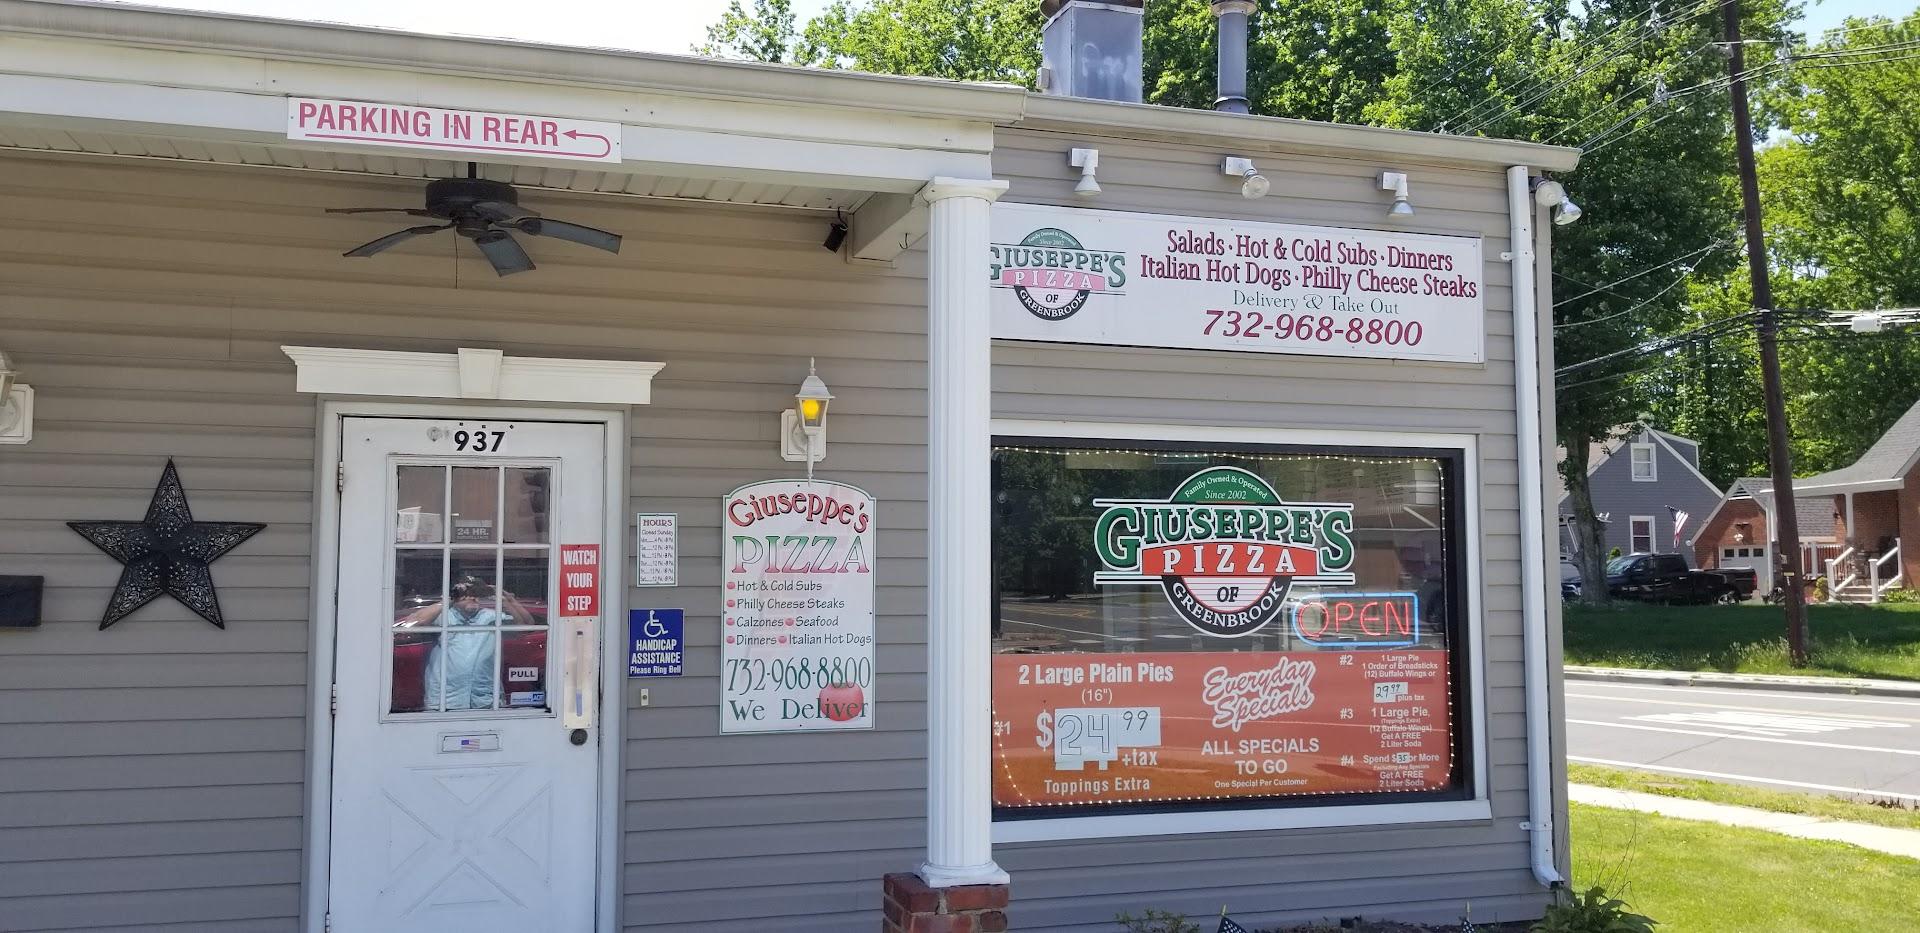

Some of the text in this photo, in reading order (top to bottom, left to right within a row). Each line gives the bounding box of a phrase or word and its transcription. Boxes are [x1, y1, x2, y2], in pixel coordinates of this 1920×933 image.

[299, 102, 559, 146] PARKING IN REAR
[1167, 229, 1453, 271] Salads Hot & Cold Subs Dinners
[1014, 270, 1093, 289] PIZZA
[1140, 254, 1477, 298] Italian Hot Dogs Philly Cheese Steaks
[1020, 289, 1086, 318] GREENBROOK
[1045, 293, 1059, 304] OF
[1234, 289, 1299, 311] Delivery
[1329, 294, 1364, 313] Take
[1370, 297, 1400, 315] Out
[1203, 310, 1423, 346] 732-968-8800
[454, 430, 505, 452] 937
[1185, 475, 1268, 499] Family Owned & Operated
[1205, 490, 1247, 500] Since 2002
[728, 492, 869, 534] Giuseppe's
[457, 527, 489, 536] 24 HR.
[1094, 505, 1354, 571] GIUSEPPE'S
[563, 550, 596, 565] WATCH
[732, 535, 870, 573] PIZZA
[1163, 545, 1296, 574] PIZZA
[566, 572, 593, 588] YOUR
[737, 580, 822, 591] Hot & Cold Subs
[1216, 586, 1240, 603] OF
[567, 595, 592, 611] STEP
[737, 598, 845, 612] Philly Cheese Steaks
[1172, 582, 1284, 628] GREENBROOK
[736, 616, 839, 627] Calzones Seafood
[1299, 601, 1409, 637] OPEN
[636, 639, 677, 651] HANDICAP
[736, 633, 871, 646] Dinners Italian Hot Dogs
[631, 652, 681, 664] ASSISTANCE
[1339, 654, 1353, 666] #2
[1367, 662, 1387, 670] Order
[1387, 654, 1406, 663] Large
[510, 670, 535, 678] PULL
[630, 665, 681, 674] Please Ring Bell
[727, 656, 870, 695] 732-968-8800
[1018, 662, 1175, 686] 2 Large Plain Pies
[1364, 670, 1377, 679] (12)
[1405, 670, 1426, 678] Wings
[1203, 655, 1316, 705] Everyday
[1081, 687, 1113, 705] (16")
[1375, 685, 1389, 698] 29
[1397, 694, 1413, 702] plus
[728, 698, 869, 721] We Deliver
[1212, 683, 1315, 732] Specials
[1340, 706, 1430, 719] #3 1 Large Pie,
[1381, 732, 1394, 740] Get
[1395, 732, 1401, 740] A
[1382, 724, 1407, 732] Buffalo
[1201, 737, 1320, 755] ALL SPECIALS
[1380, 740, 1386, 748] 2
[1121, 748, 1158, 766] +tax
[1341, 755, 1354, 766] #4
[1363, 754, 1390, 764] Spend
[1418, 753, 1440, 762] More
[1235, 758, 1288, 775] TO GO
[1379, 770, 1424, 779] Get A FREE
[1044, 777, 1151, 795] Toppings Extra
[1214, 778, 1308, 789] One Special Per Customer
[1379, 780, 1385, 788] 2
[1405, 778, 1425, 787] Soda
